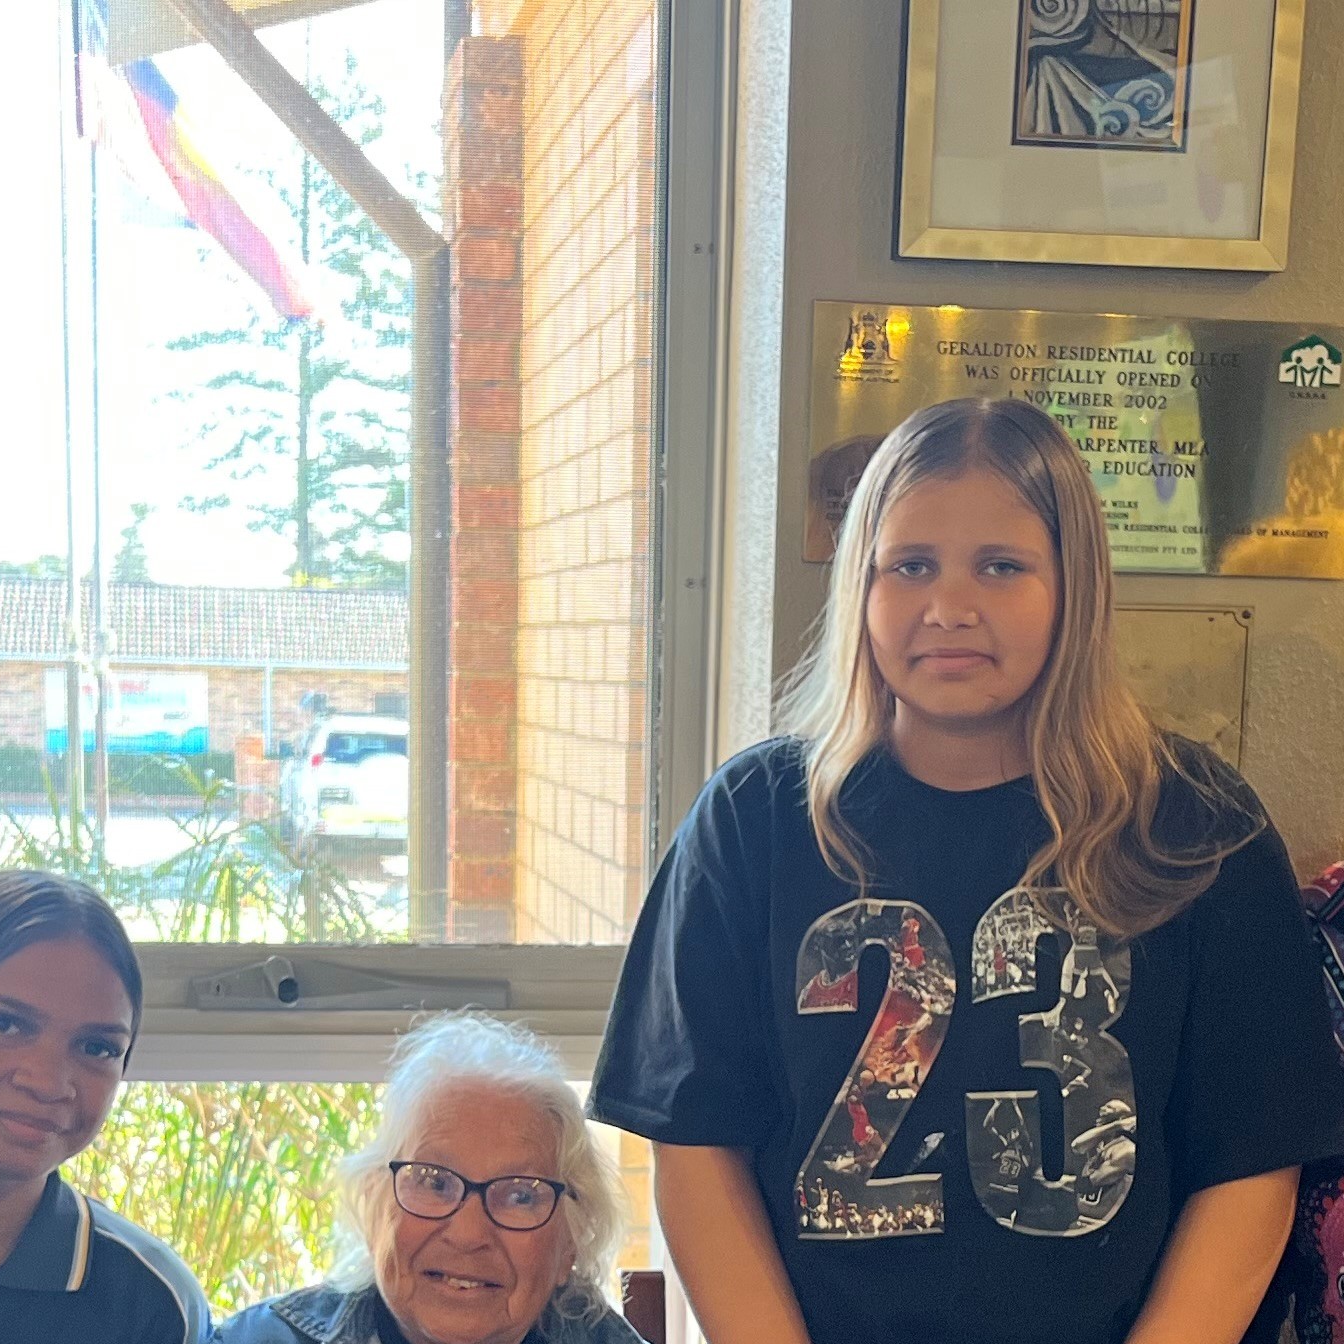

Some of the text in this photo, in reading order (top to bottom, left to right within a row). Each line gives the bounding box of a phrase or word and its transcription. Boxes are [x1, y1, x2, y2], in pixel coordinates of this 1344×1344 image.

[937, 340, 1241, 367] GERALDTON RESIDENTIAL COLLEGE
[965, 364, 999, 380] WAS
[1010, 366, 1106, 385] OFFICIALLY
[1116, 371, 1181, 388] OPENED
[1024, 389, 1114, 407] NOVEMBER
[1124, 394, 1168, 410] 2002
[1088, 415, 1119, 430] THE
[1174, 440, 1210, 455] MLA
[1103, 460, 1197, 478] EDUCATION
[794, 885, 1139, 1241] 23
